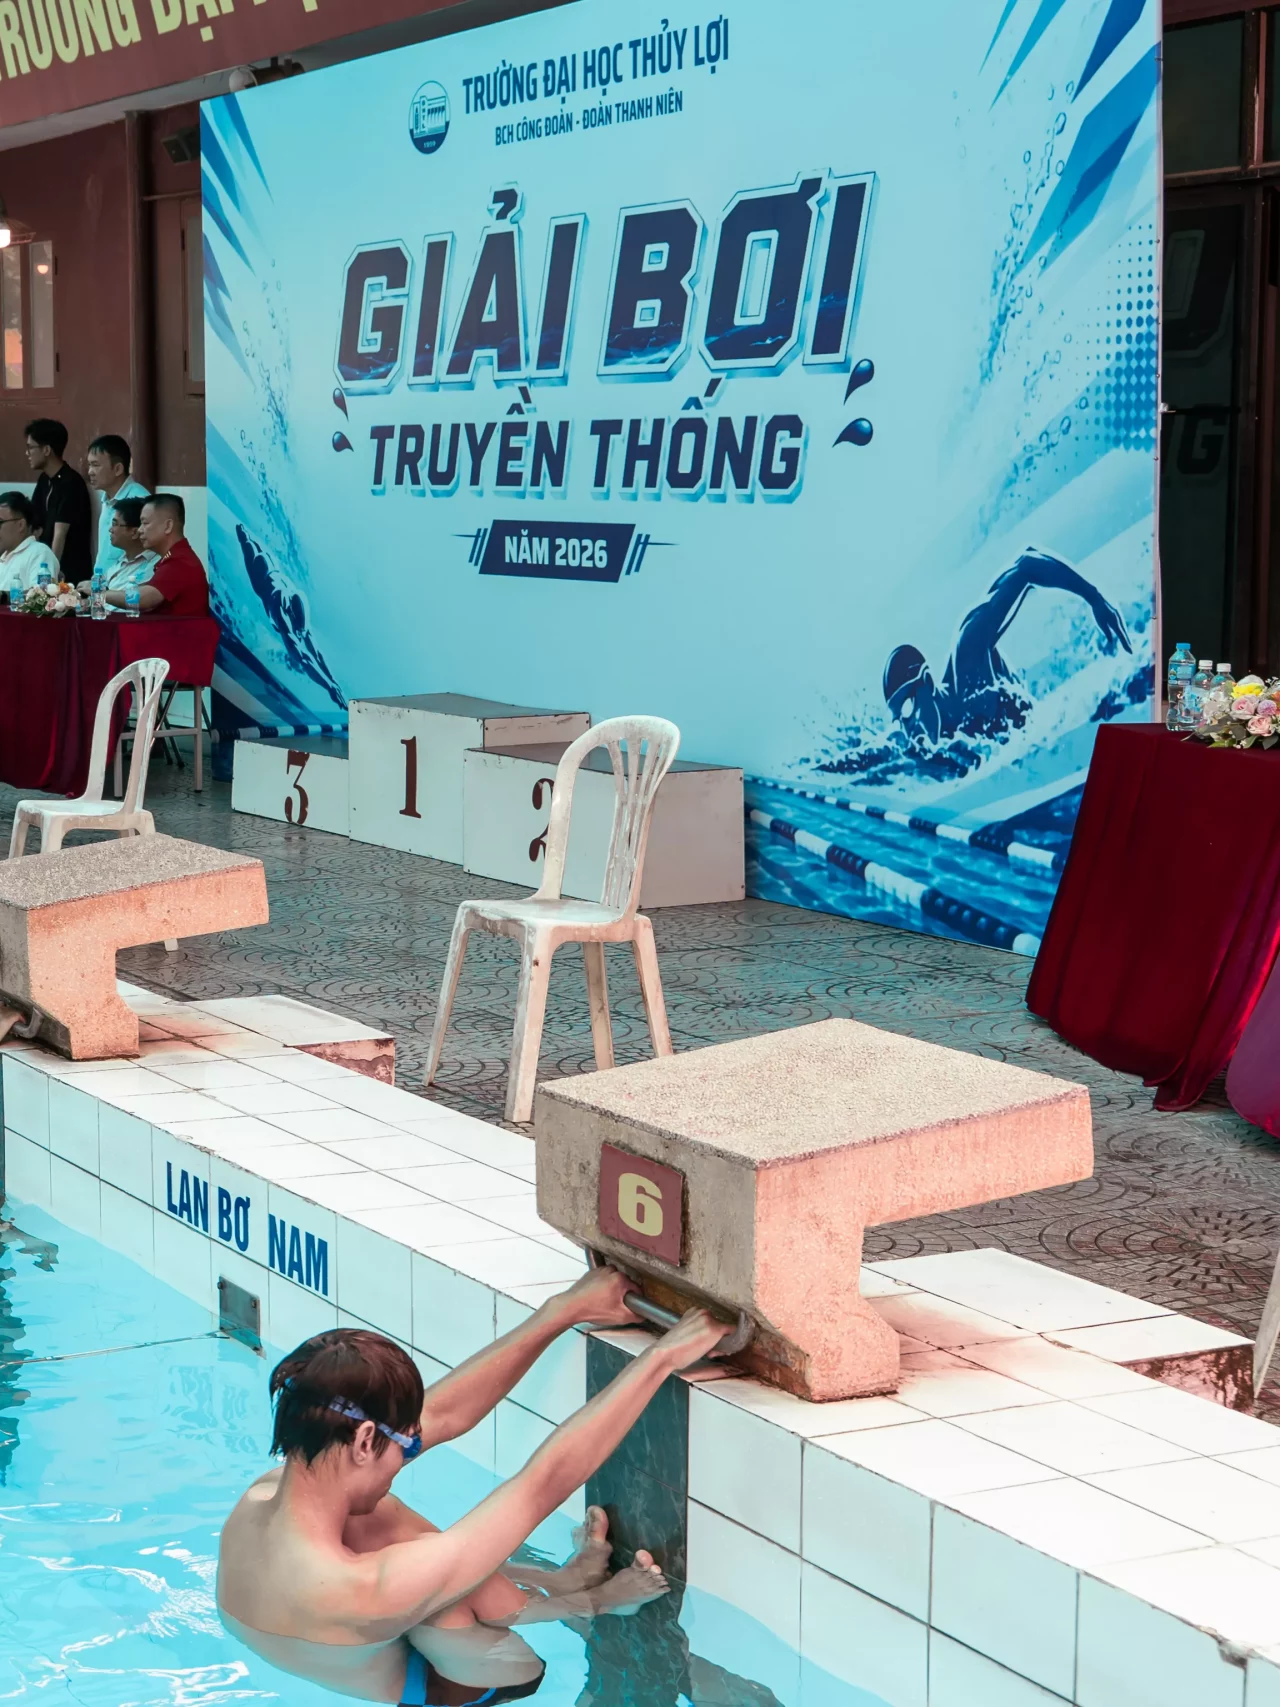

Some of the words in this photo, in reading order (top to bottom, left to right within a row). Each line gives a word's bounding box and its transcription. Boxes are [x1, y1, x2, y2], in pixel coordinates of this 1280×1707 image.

[462, 60, 537, 114] TRƯỜNG
[543, 53, 576, 104] ĐẠI
[583, 42, 623, 96] HỌC
[629, 18, 688, 79] THỦY
[694, 14, 729, 74] LỢI
[495, 124, 514, 146] BCH
[517, 116, 542, 142] CÔNG
[545, 108, 573, 137] ĐOÀN
[582, 100, 612, 129] ĐOÀN
[615, 96, 653, 123] THANH
[656, 87, 683, 116] NIÊN
[334, 184, 586, 392] GIẢI
[598, 170, 875, 379] BƠI
[370, 386, 570, 489] TRUYỀN
[589, 377, 804, 490] THỐNG
[504, 529, 549, 565] NĂM
[555, 538, 608, 568] 2026
[284, 749, 310, 825] 3
[399, 735, 422, 819] 1
[166, 1161, 209, 1233] LAN
[218, 1186, 251, 1252] BƠ
[268, 1213, 328, 1297] NAM
[618, 1172, 664, 1237] 6
